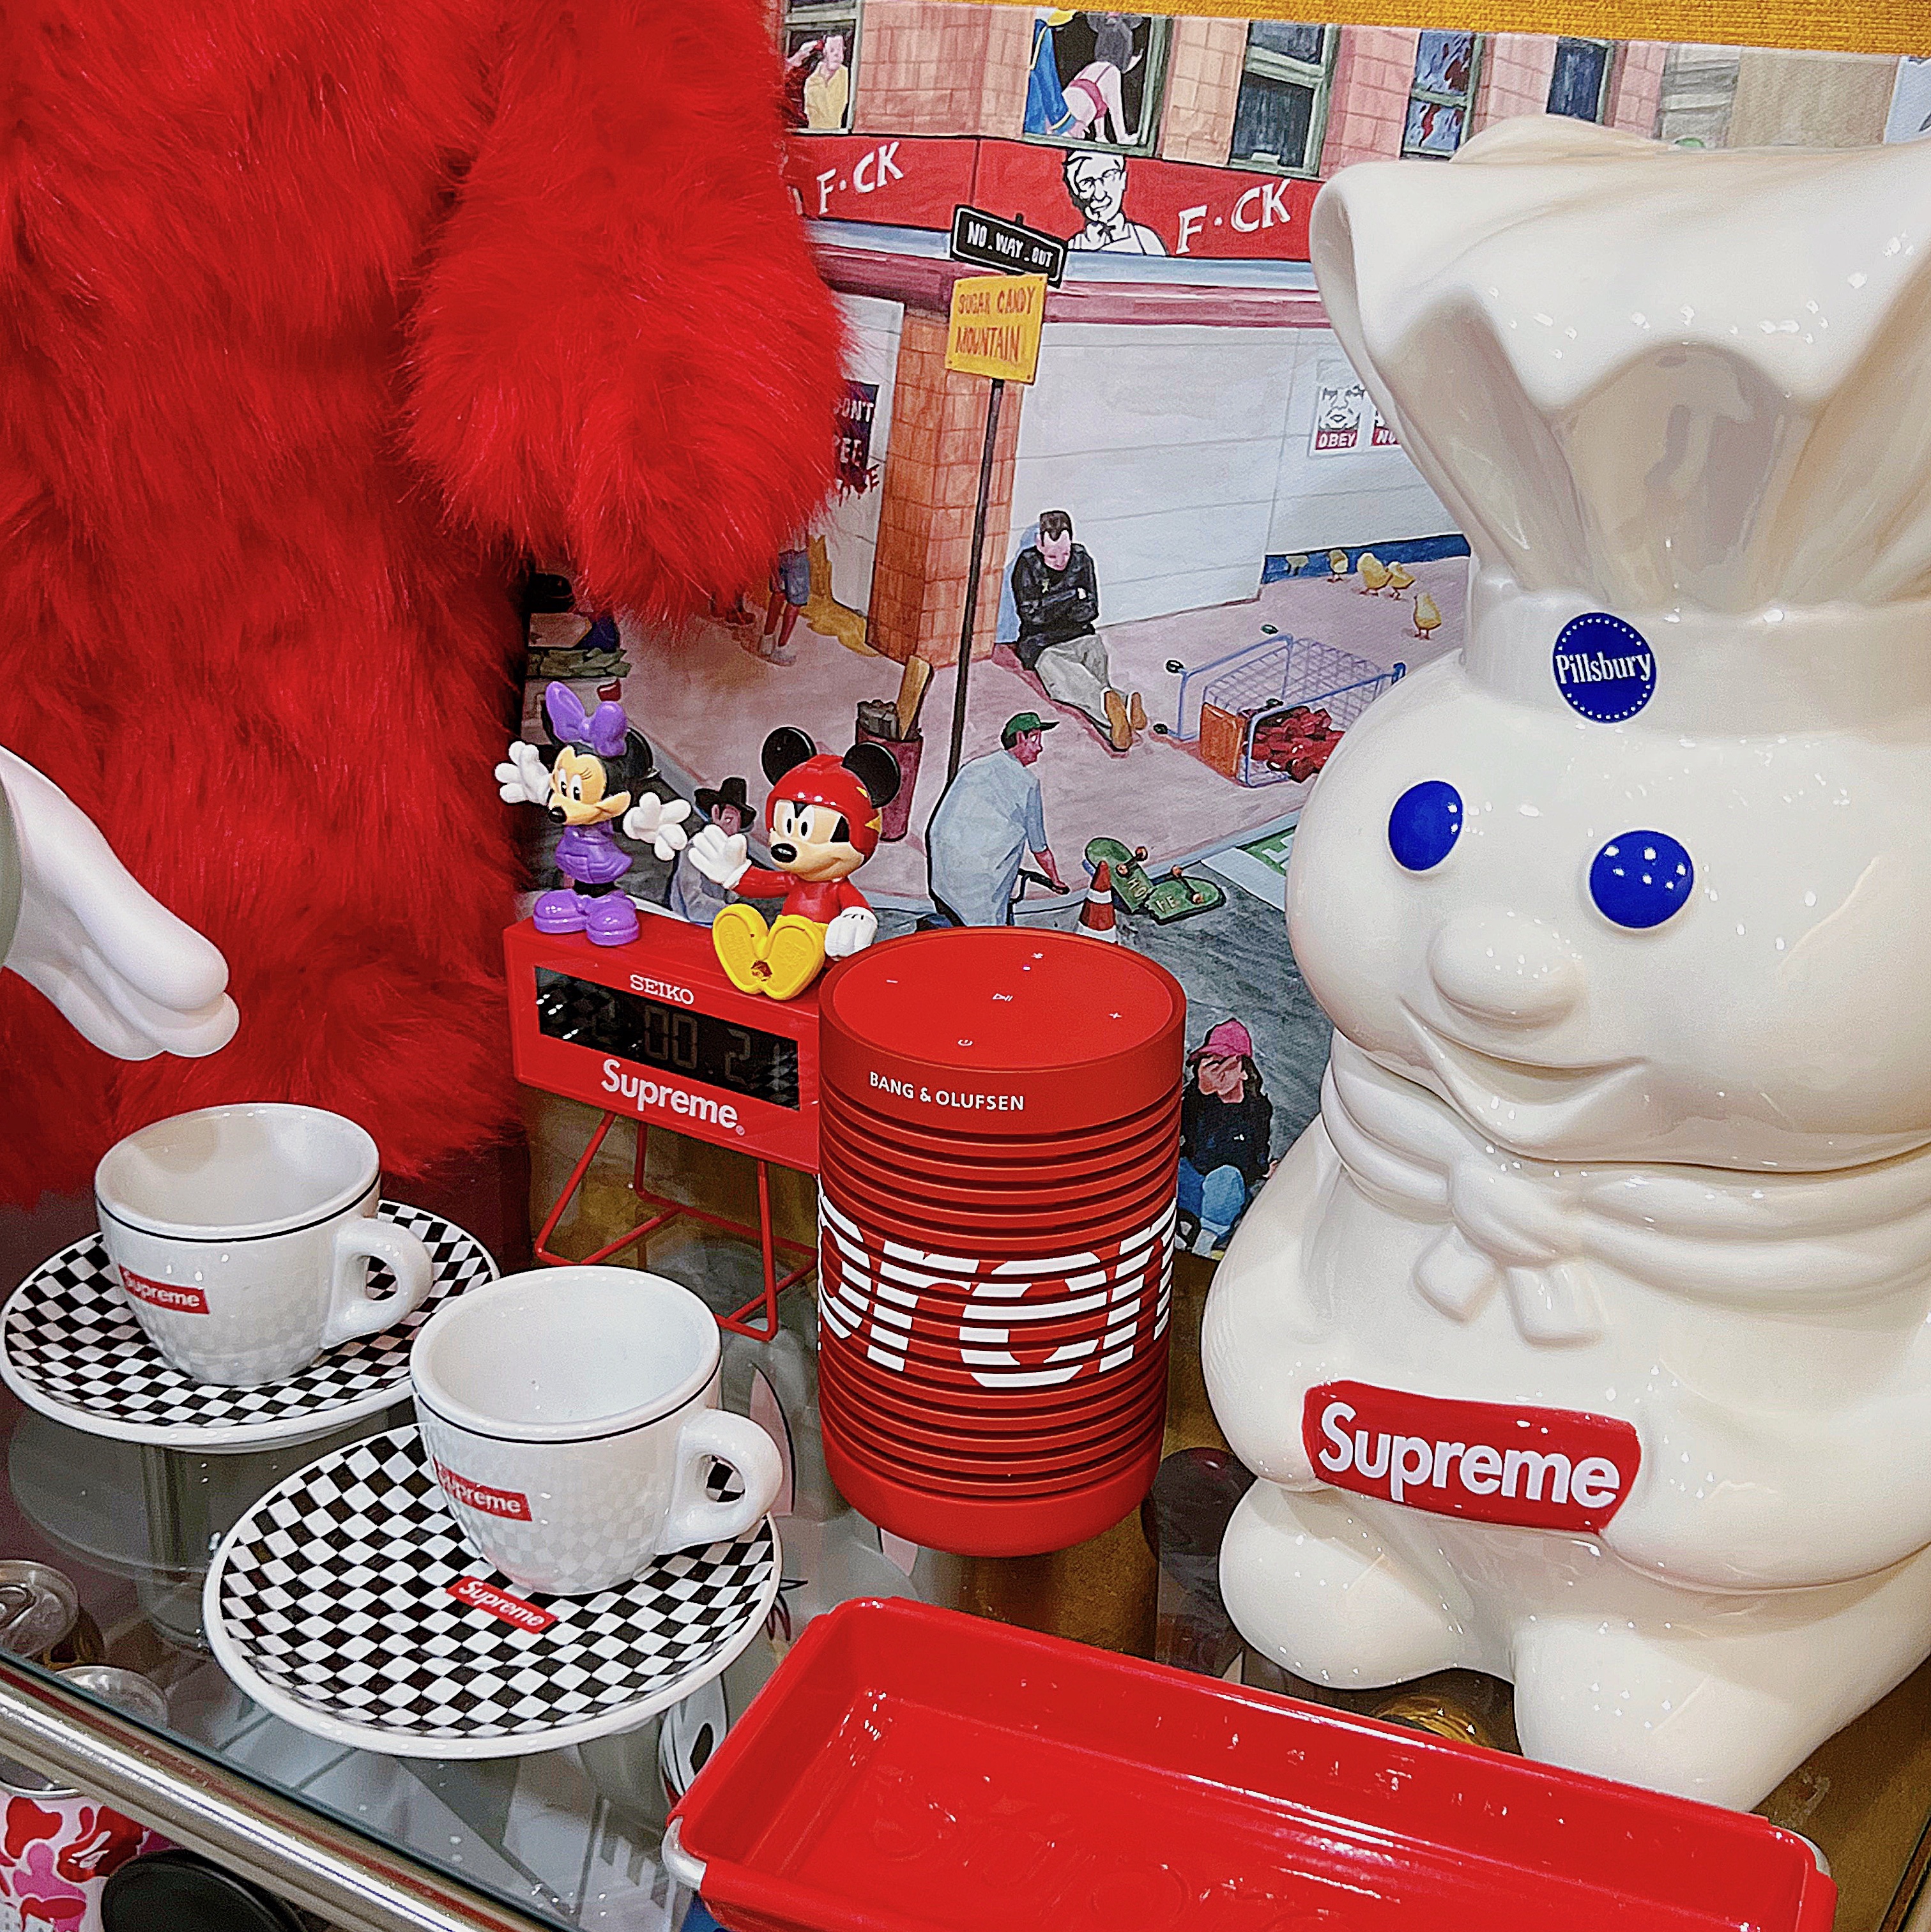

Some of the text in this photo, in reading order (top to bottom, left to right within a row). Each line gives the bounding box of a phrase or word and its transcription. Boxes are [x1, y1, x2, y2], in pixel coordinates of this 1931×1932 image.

[958, 286, 1035, 316] SUGAR CANDY
[955, 325, 1022, 363] MOUNTAIN
[1318, 432, 1357, 448] OBEY
[1555, 650, 1651, 684] Pillsbury
[629, 974, 695, 1005] SEIKO
[600, 1058, 739, 1129] Supreme
[869, 1071, 1024, 1111] BANG & OLUFSEN
[1318, 1401, 1621, 1509] Supreme
[458, 1580, 545, 1627] Supreme
